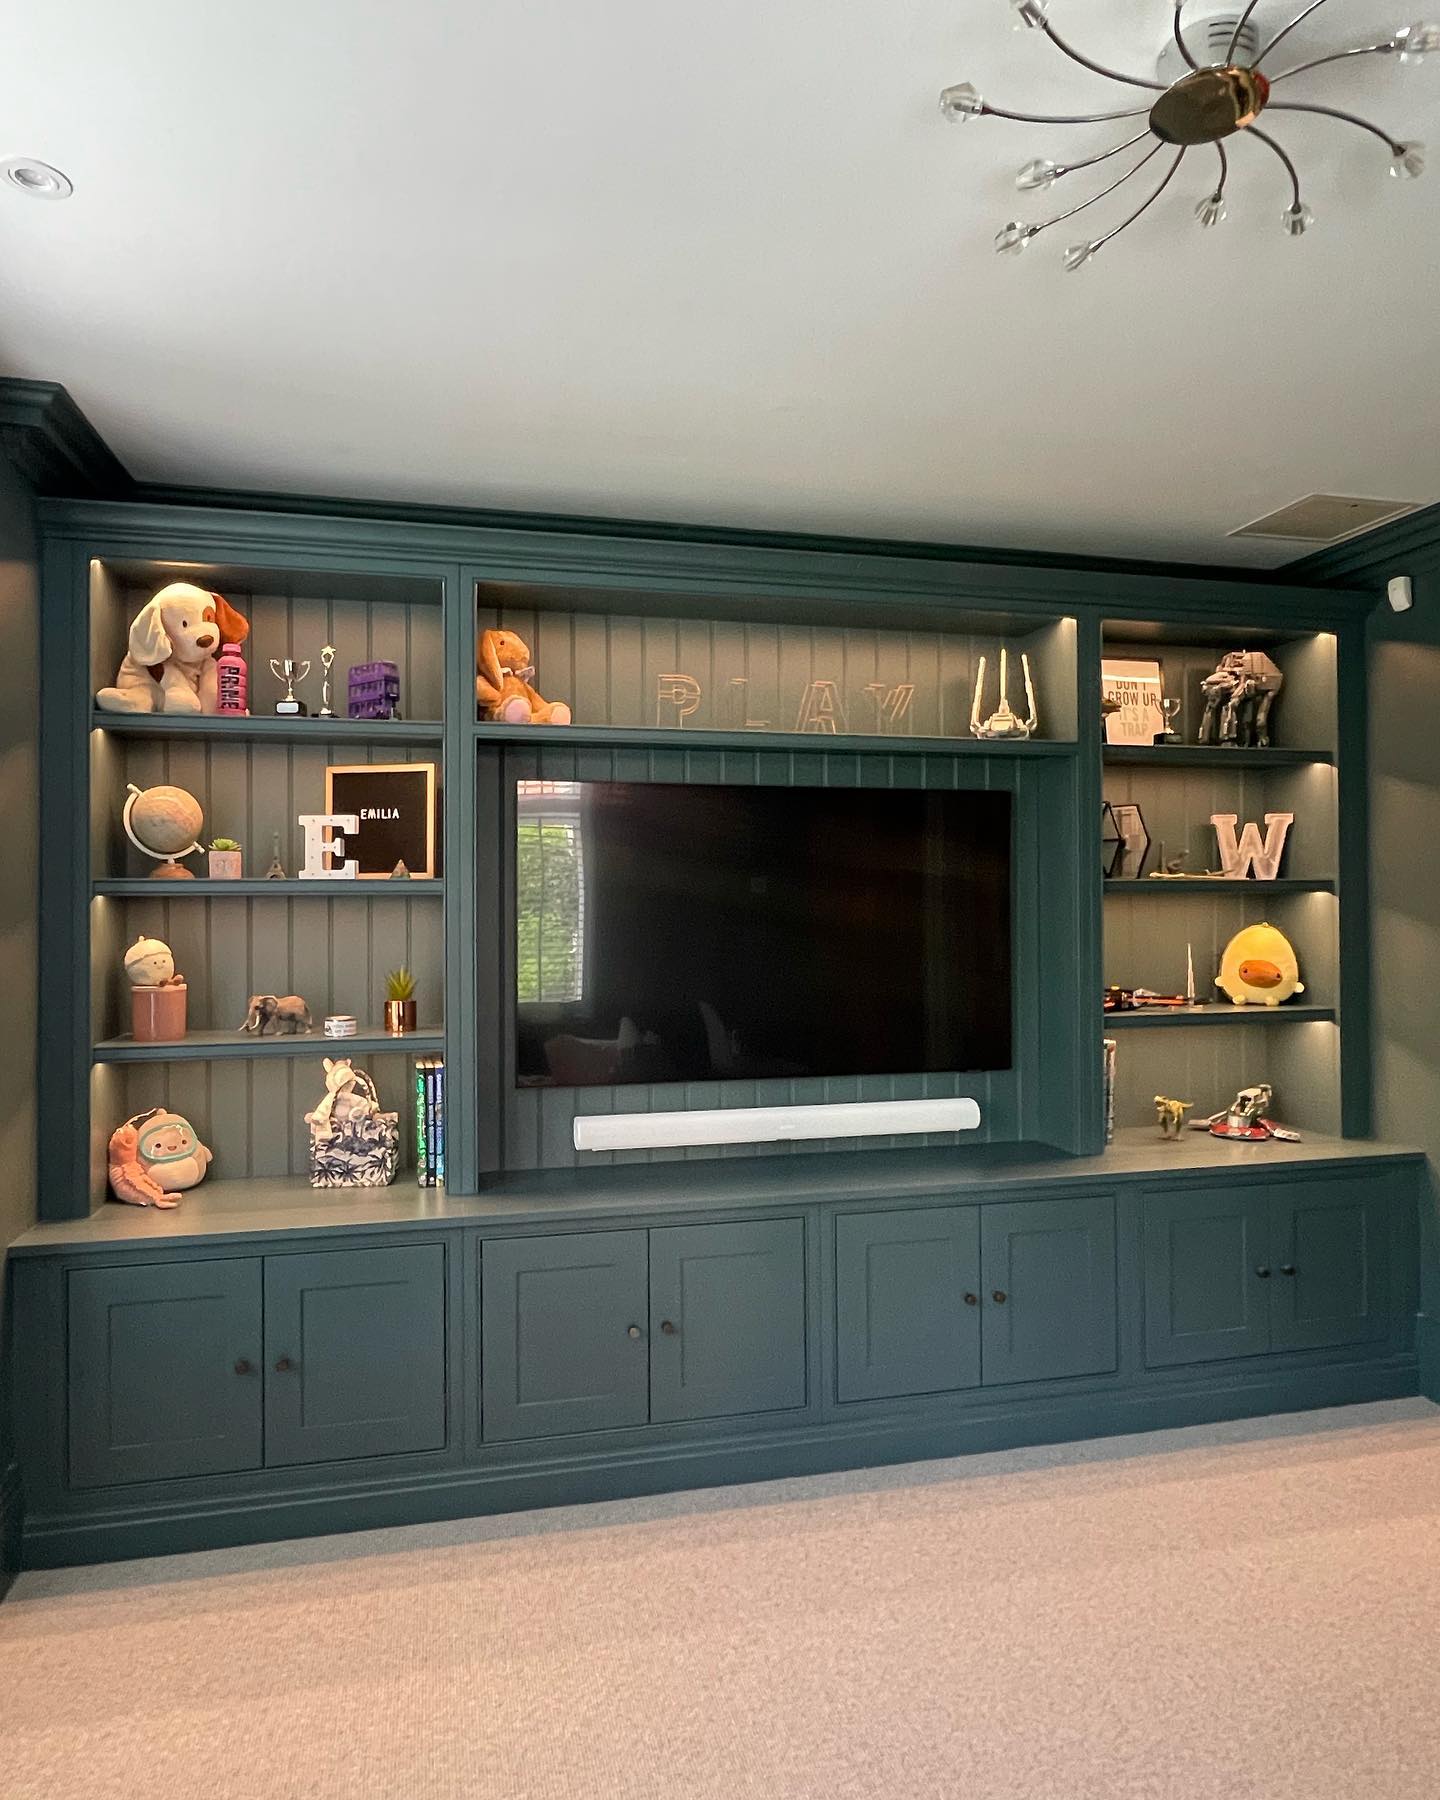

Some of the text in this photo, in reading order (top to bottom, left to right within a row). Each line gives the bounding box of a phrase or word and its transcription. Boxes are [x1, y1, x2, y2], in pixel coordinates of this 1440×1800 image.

[1115, 681, 1147, 691] DONT
[657, 673, 915, 735] PLAY
[1108, 691, 1157, 707] GROW UP
[1120, 722, 1149, 737] TRAP
[360, 808, 400, 820] EMILIA
[298, 814, 360, 880] E
[1210, 813, 1294, 880] W
